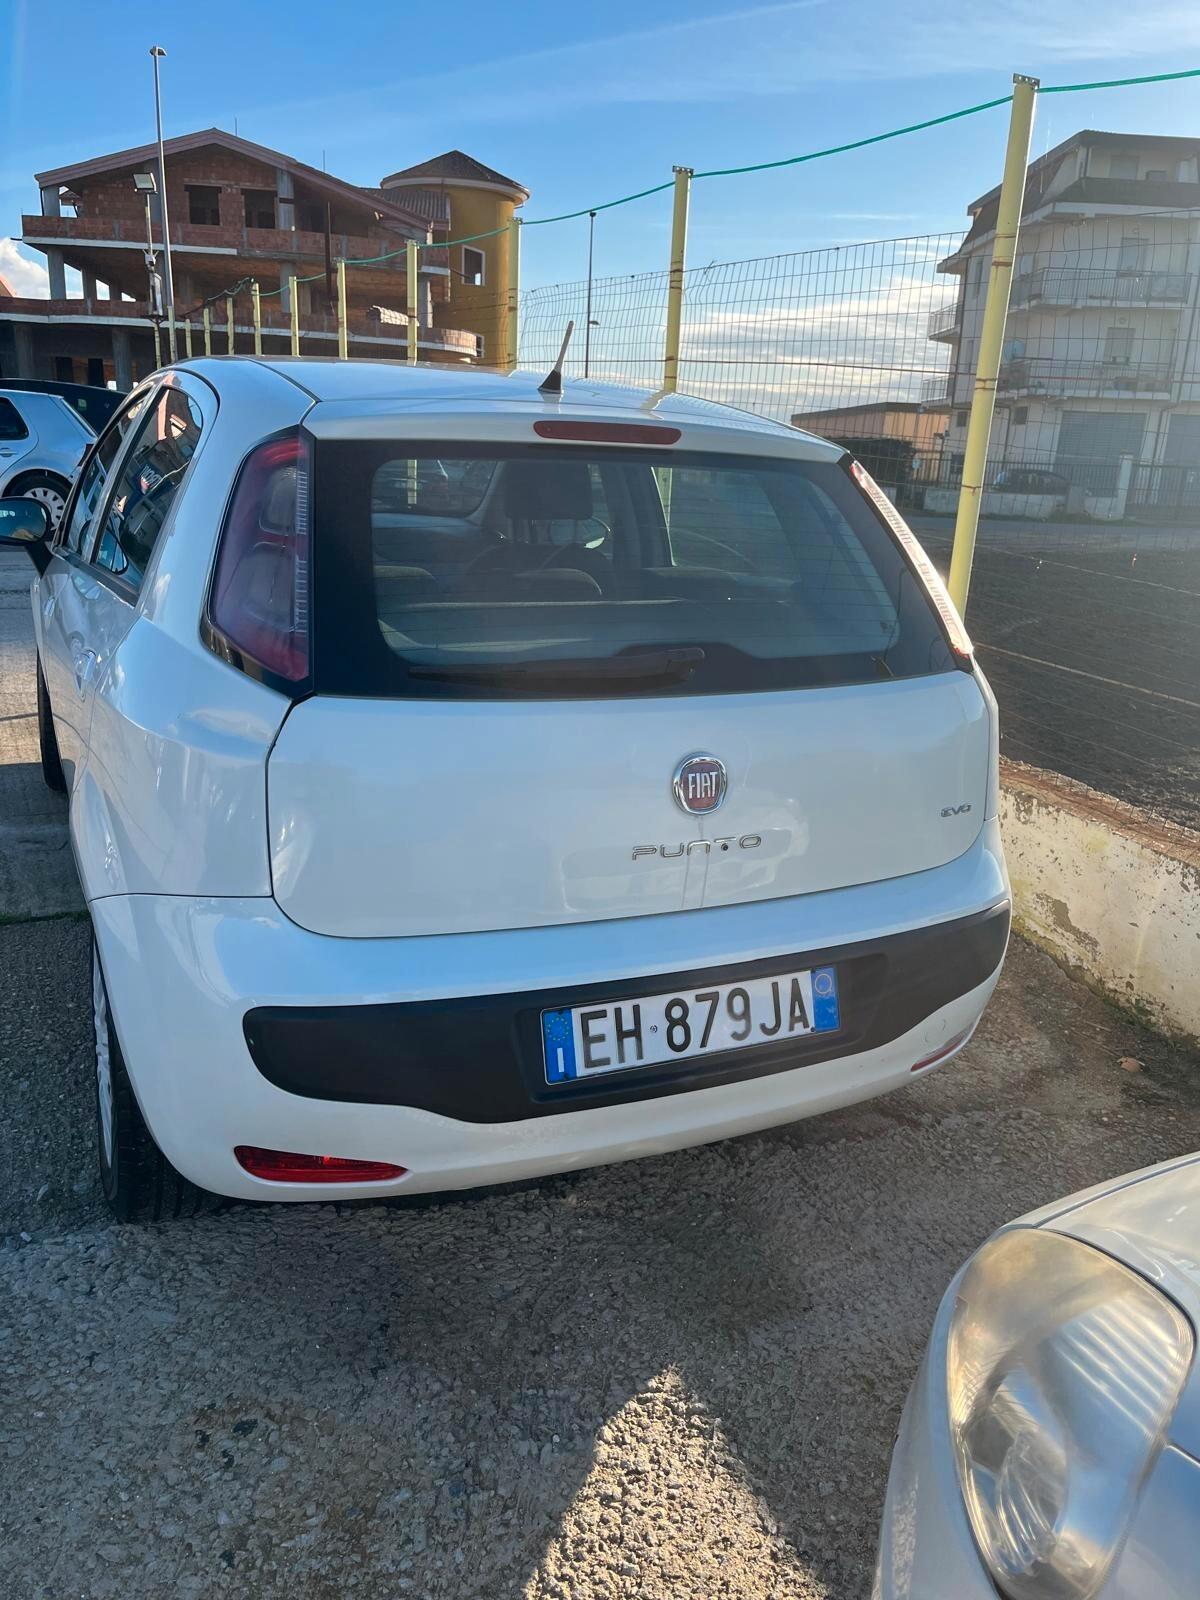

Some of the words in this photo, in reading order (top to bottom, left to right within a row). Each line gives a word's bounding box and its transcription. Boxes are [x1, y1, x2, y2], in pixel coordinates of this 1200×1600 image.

[688, 771, 718, 799] FIAT
[940, 803, 972, 818] EVO
[631, 833, 762, 861] PUNTO
